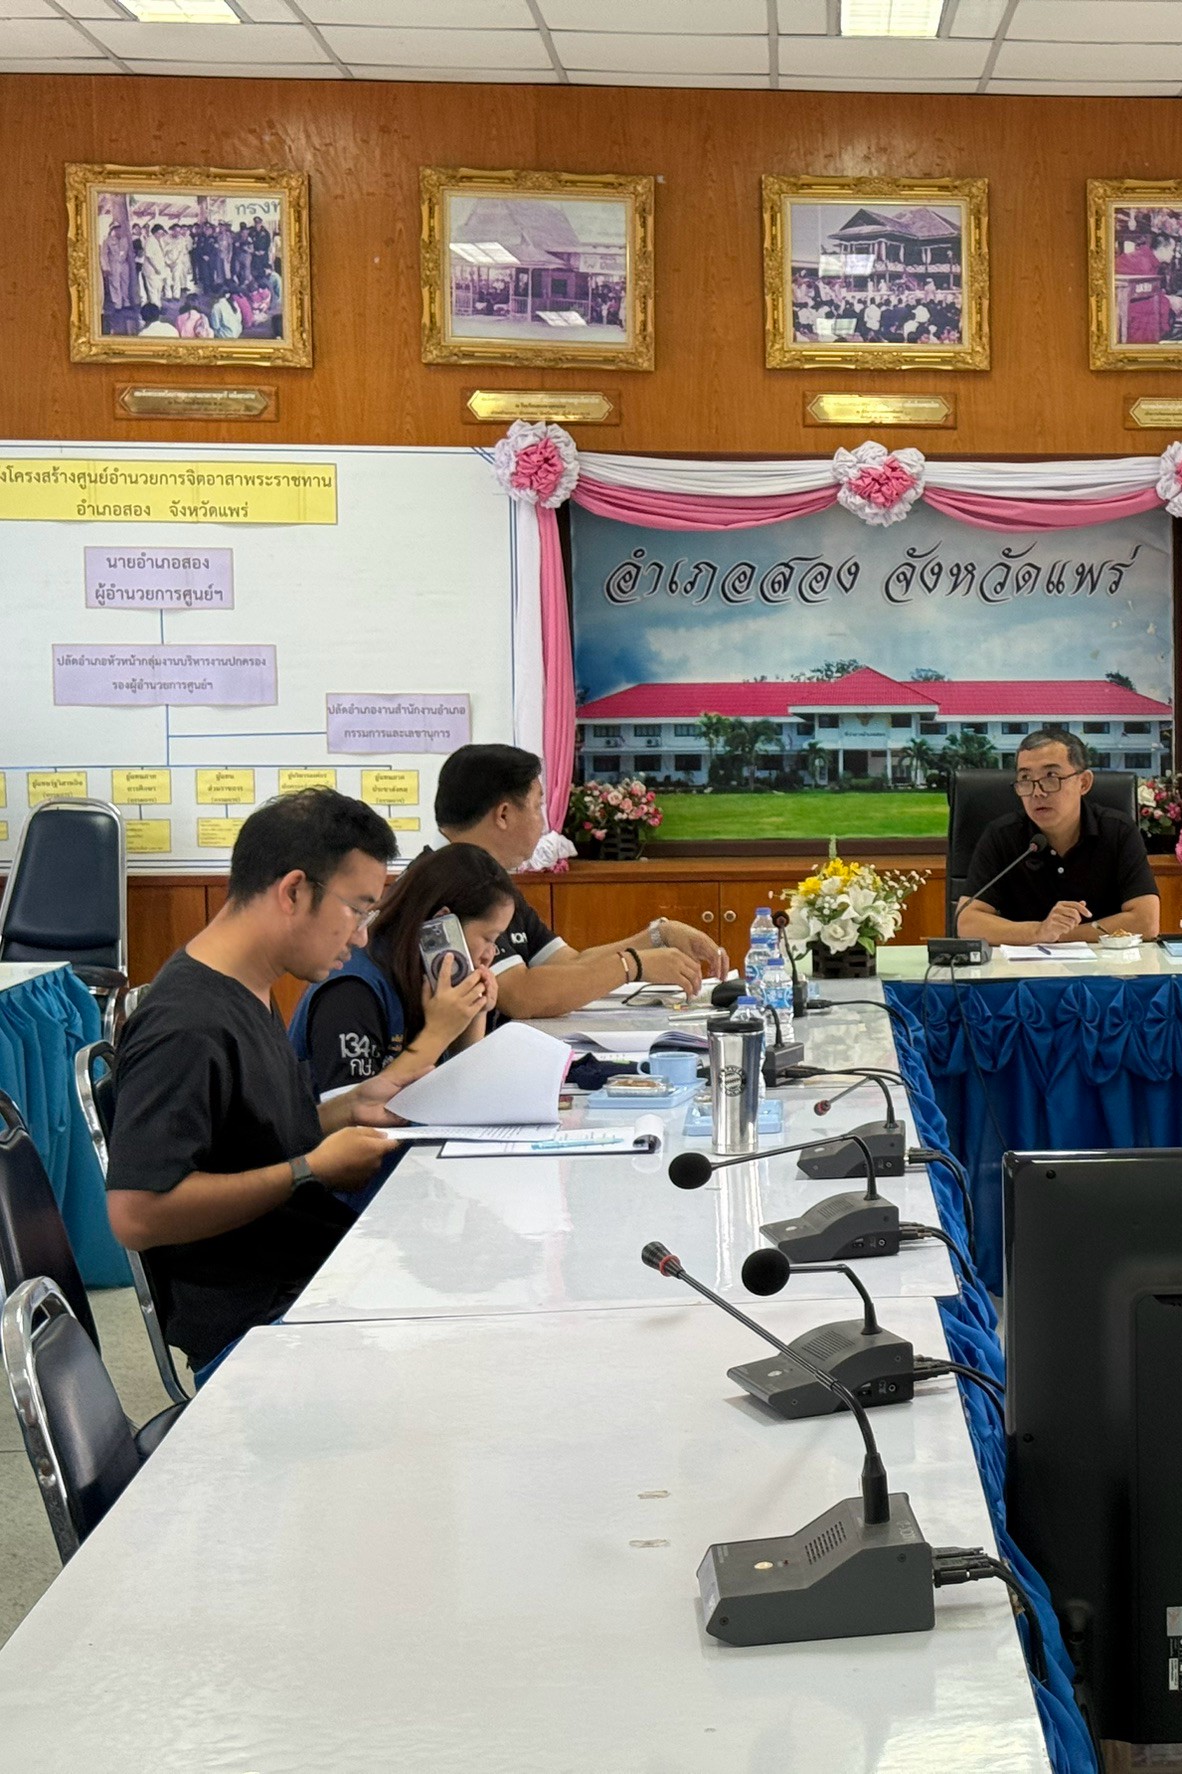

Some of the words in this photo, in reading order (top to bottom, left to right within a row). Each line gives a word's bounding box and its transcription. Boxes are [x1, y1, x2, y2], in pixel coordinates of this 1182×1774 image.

[76, 499, 151, 517] อำเภอสอง
[169, 500, 249, 518] จังหวัดแพร่
[106, 552, 210, 569] นายอำเภอสอง
[602, 545, 862, 607] อำเภอสอง
[882, 538, 1144, 606] จังหวัดแพร่
[95, 583, 224, 607] ผู้อำนวยการศูนย์ฯ
[112, 677, 213, 694] รองผู้อำนวยการศูนย์ฯ
